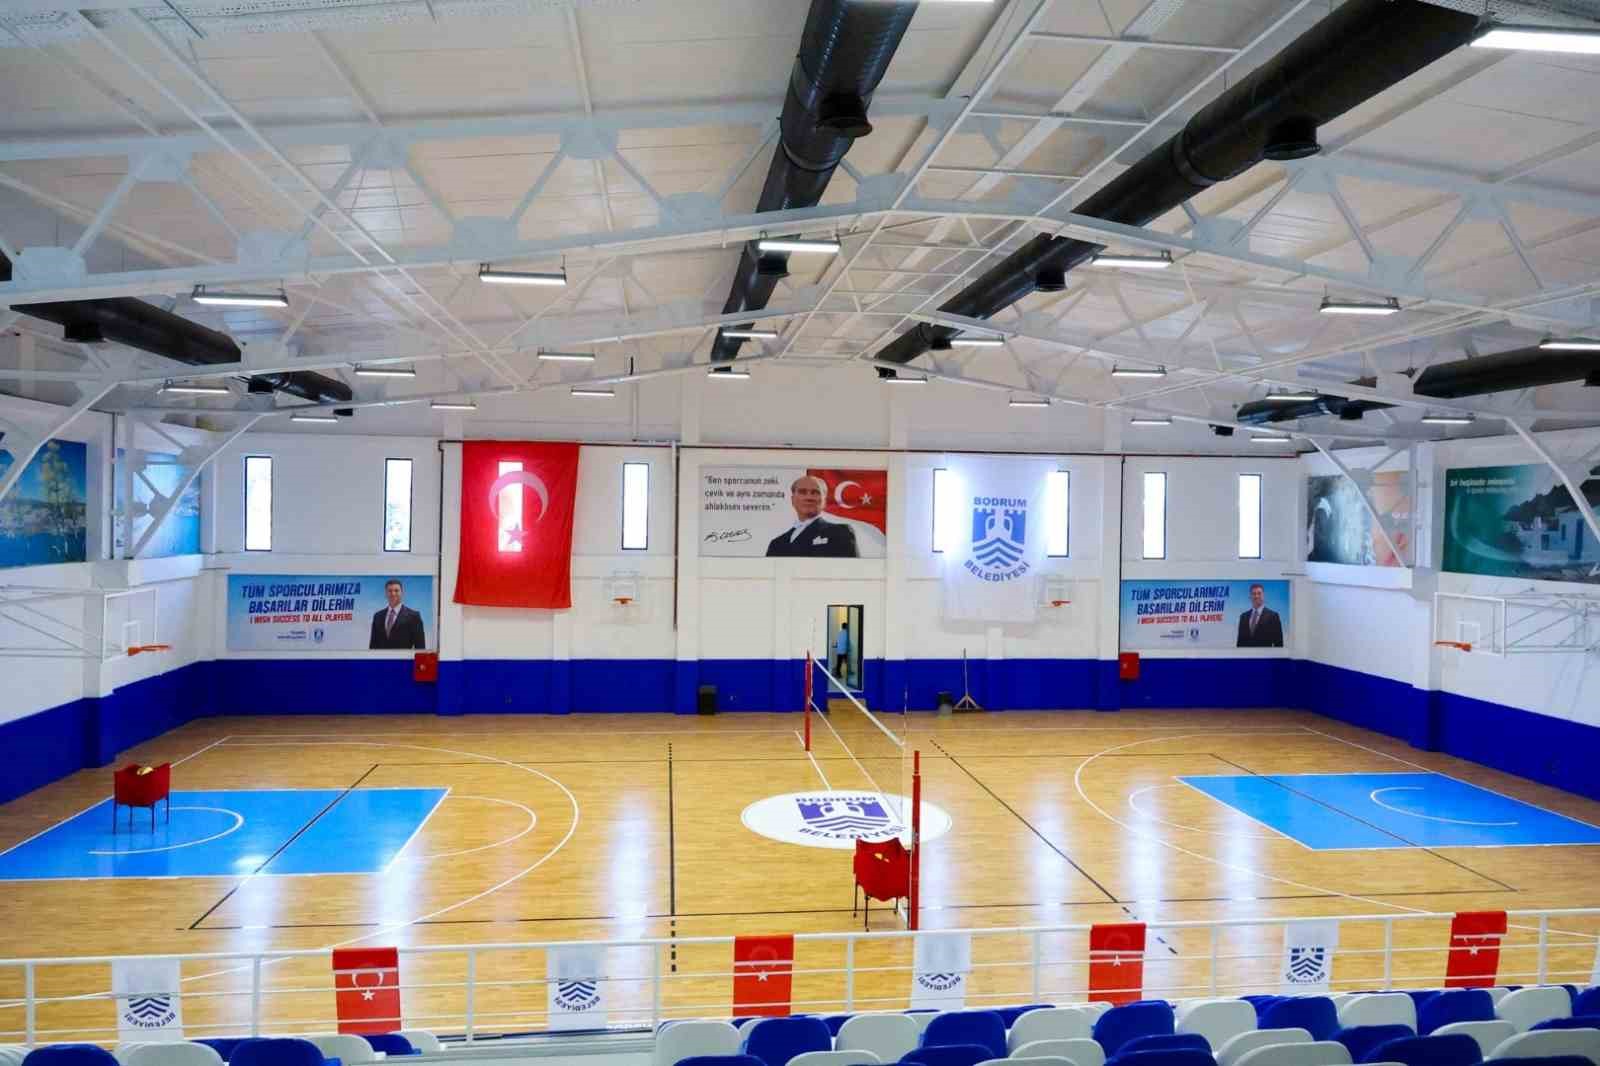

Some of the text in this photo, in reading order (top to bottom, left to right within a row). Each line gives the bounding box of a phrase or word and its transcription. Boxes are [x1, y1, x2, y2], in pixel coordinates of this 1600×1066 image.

[752, 490, 785, 498] zamanda
[973, 497, 1027, 507] BODRUM
[269, 582, 361, 598] SPORCULARIMIZA
[1153, 586, 1230, 600] SPORCULARIMIZA
[311, 597, 355, 611] DİLERİM
[1189, 600, 1225, 613] DİLERİM
[272, 615, 300, 623] SUCCESS
[302, 614, 311, 622] TO
[312, 614, 323, 622] ALL
[325, 613, 353, 622] PLAYERS
[1182, 615, 1188, 623] TO
